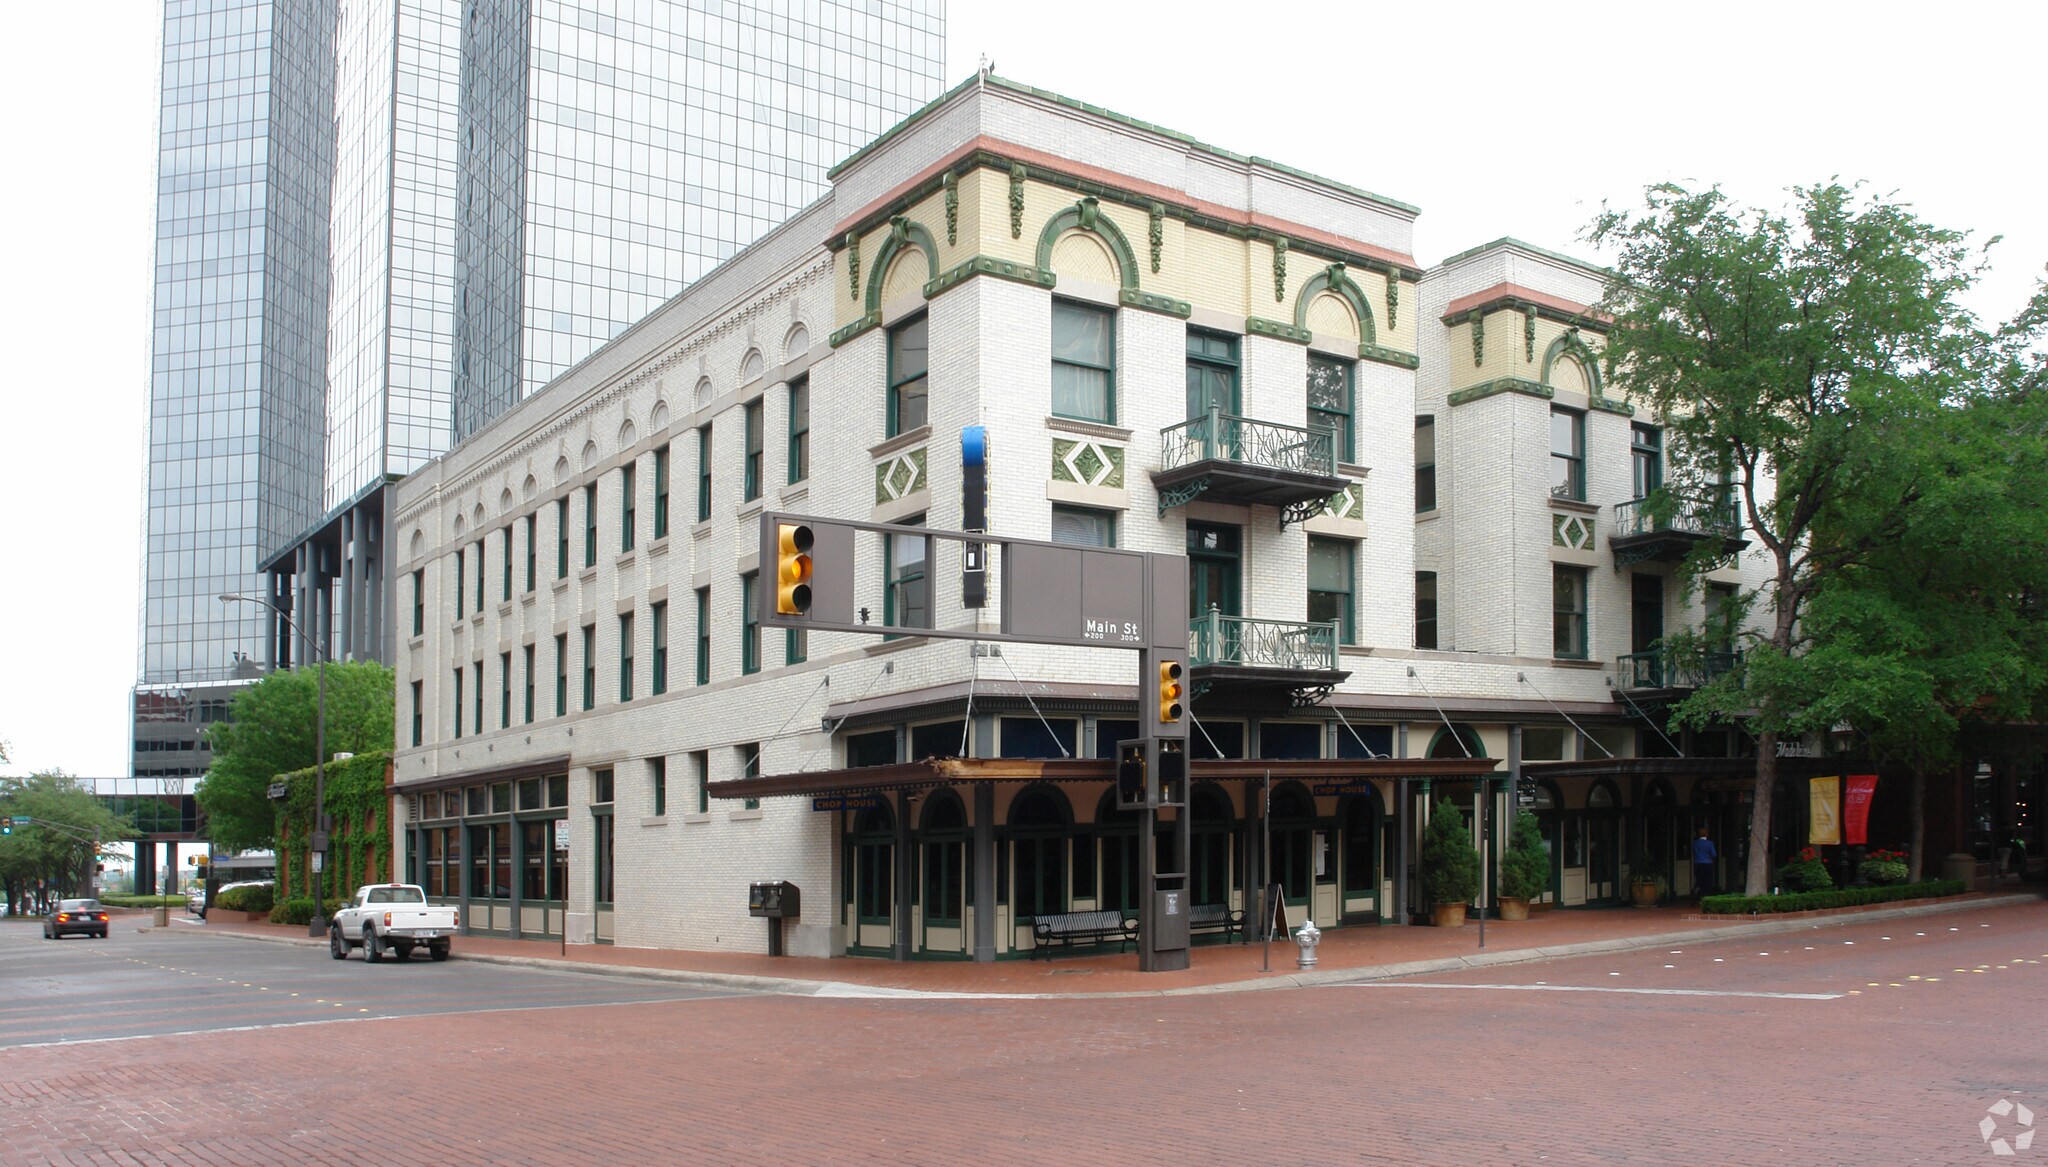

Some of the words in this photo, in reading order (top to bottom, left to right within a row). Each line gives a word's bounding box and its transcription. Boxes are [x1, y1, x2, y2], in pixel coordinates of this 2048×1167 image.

[1087, 619, 1117, 633] Main
[1123, 622, 1137, 635] St
[1339, 785, 1367, 793] HOUSE
[815, 800, 842, 809] CHOP
[846, 798, 876, 807] HOUSE
